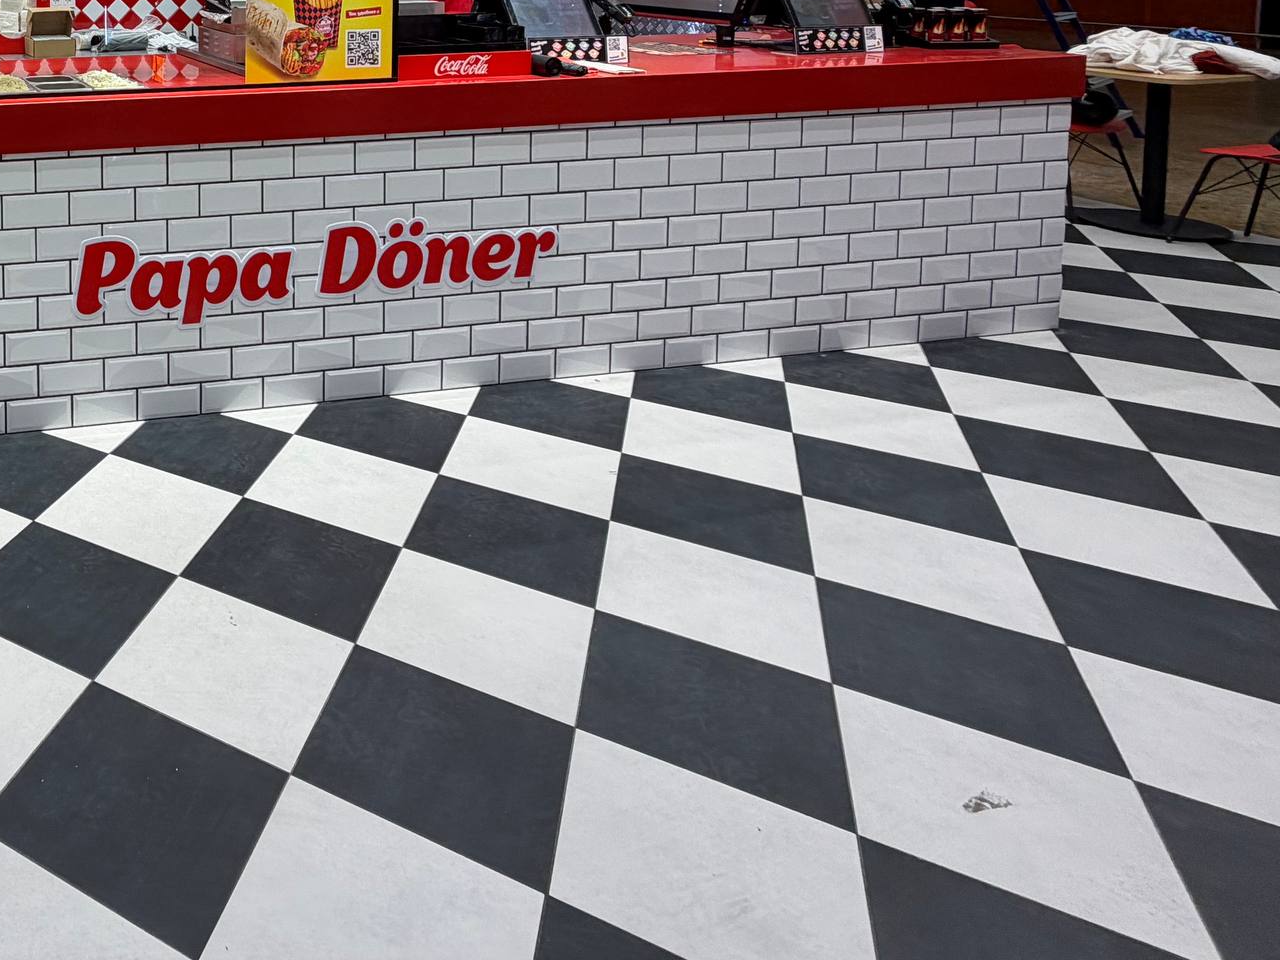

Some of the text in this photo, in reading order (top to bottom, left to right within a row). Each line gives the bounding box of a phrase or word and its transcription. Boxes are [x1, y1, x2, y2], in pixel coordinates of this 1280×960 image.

[434, 54, 492, 77] Coca-Cola
[74, 218, 558, 327] Papa Döner
